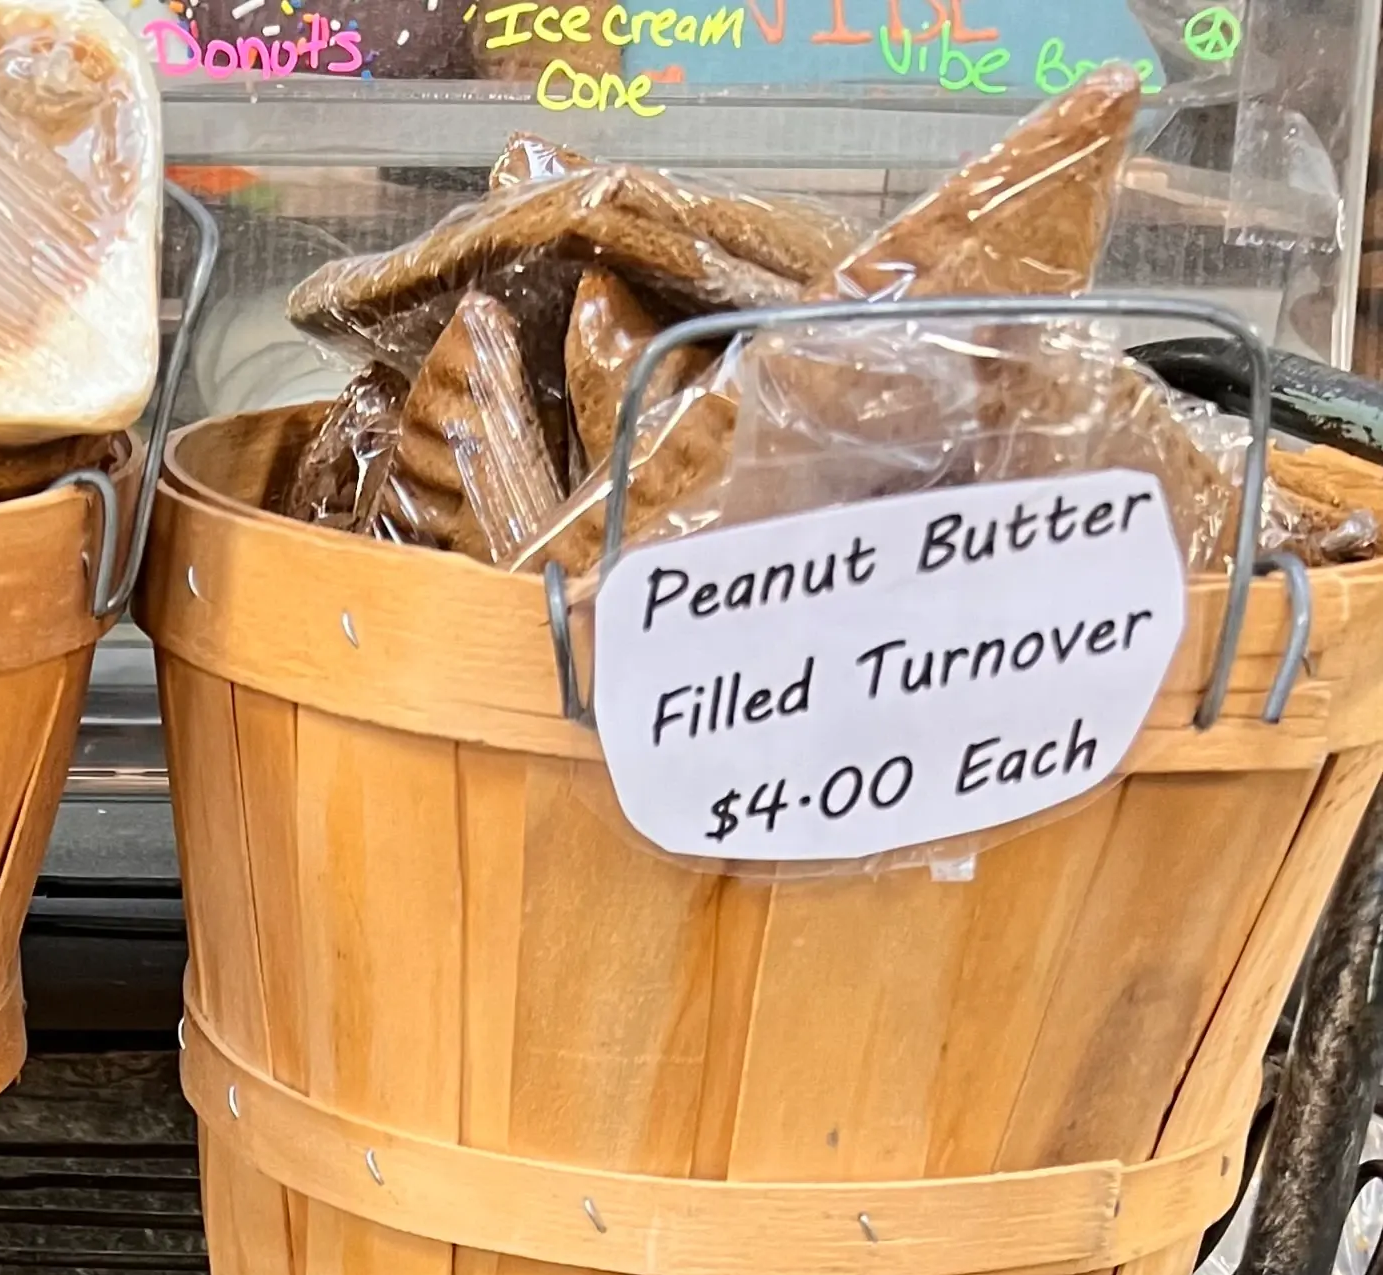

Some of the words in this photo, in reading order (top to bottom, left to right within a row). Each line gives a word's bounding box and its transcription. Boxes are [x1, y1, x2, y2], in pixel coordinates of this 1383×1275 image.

[485, 2, 592, 49] Ice
[879, 20, 1011, 93] Vibe
[536, 59, 666, 117] Cone
[640, 536, 878, 633] Peanut
[916, 490, 1154, 574] Butter
[650, 655, 816, 747] Filled
[854, 608, 1154, 699] Turnover
[954, 717, 1099, 796] Each
